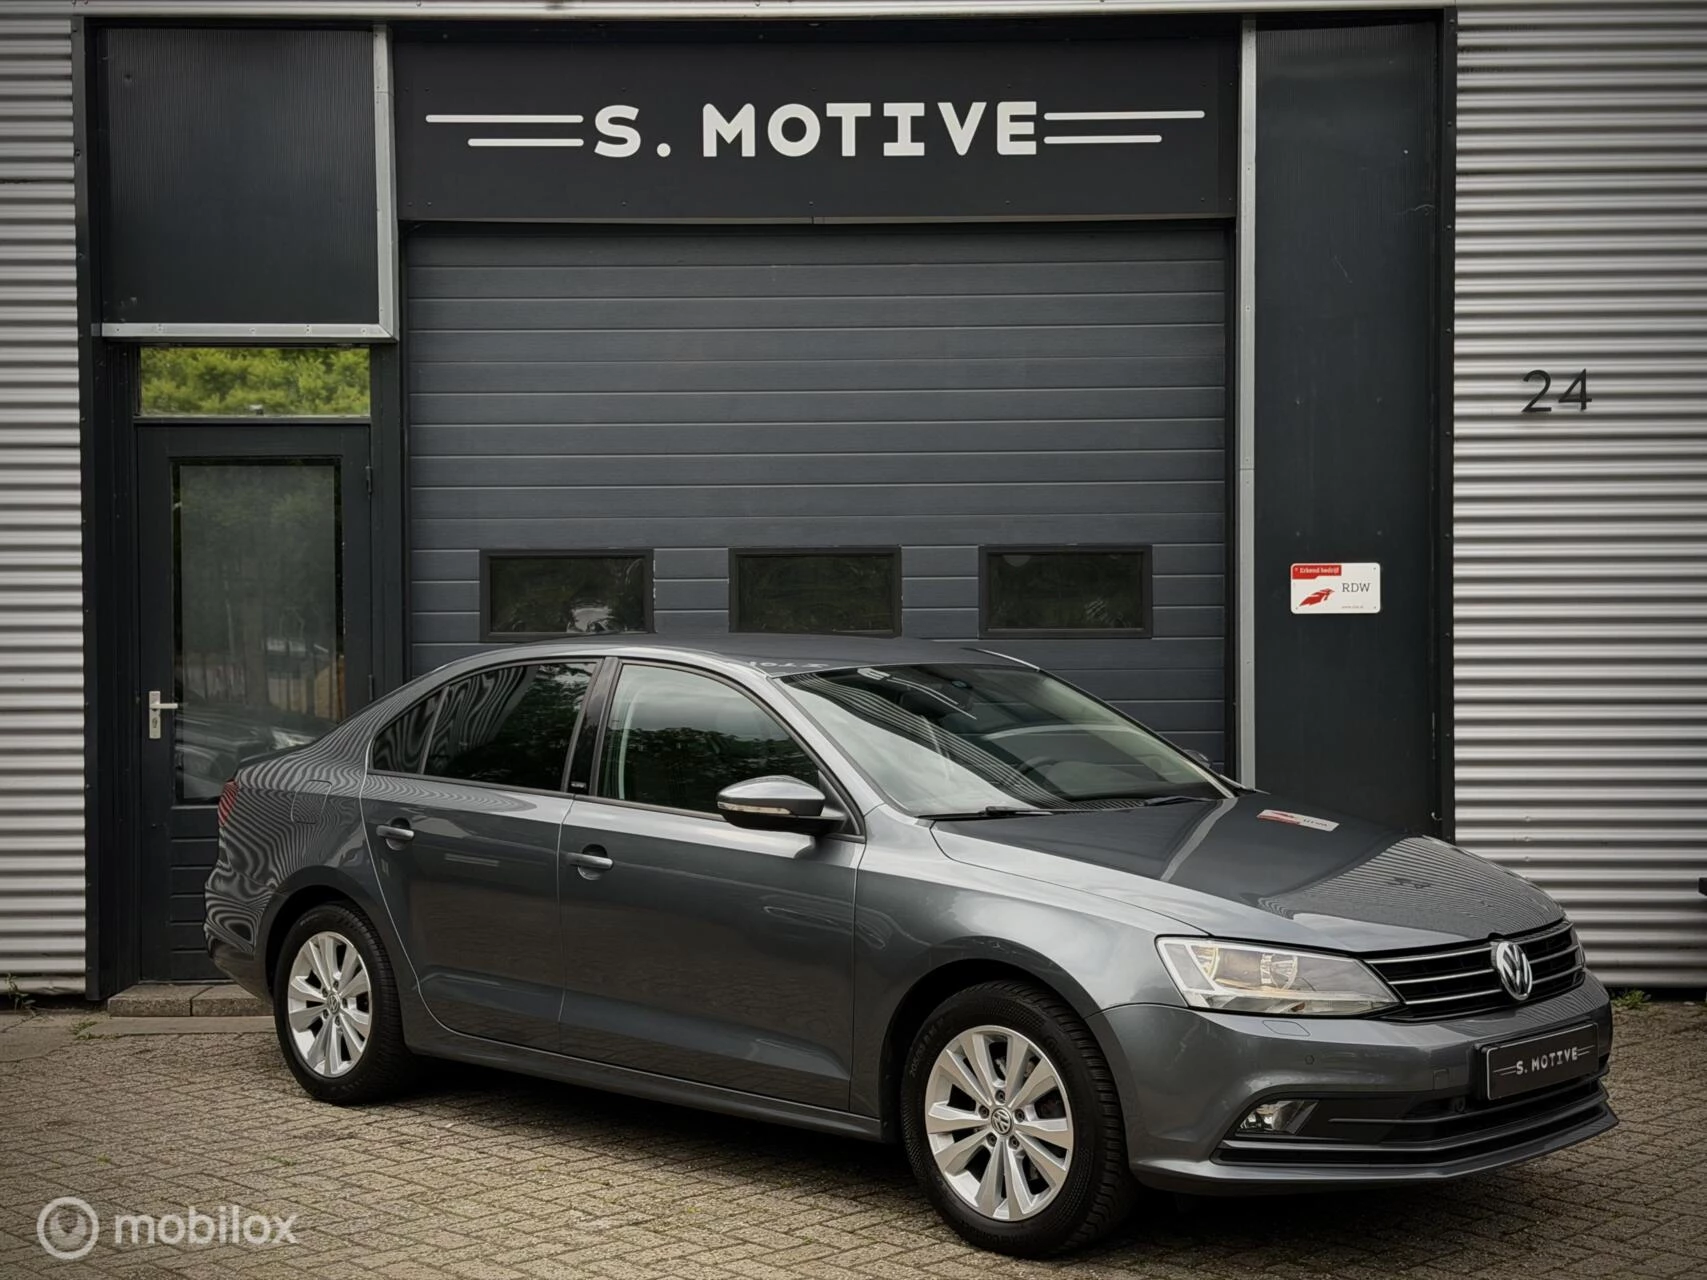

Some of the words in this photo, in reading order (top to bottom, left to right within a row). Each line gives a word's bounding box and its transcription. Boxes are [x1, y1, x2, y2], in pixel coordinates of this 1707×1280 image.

[594, 104, 671, 158] S.
[703, 102, 1037, 157] MOTIVE
[1521, 368, 1593, 412] 24
[1342, 582, 1371, 593] RDW
[1516, 1060, 1528, 1075] S.
[1531, 1047, 1578, 1072] MOTIVE
